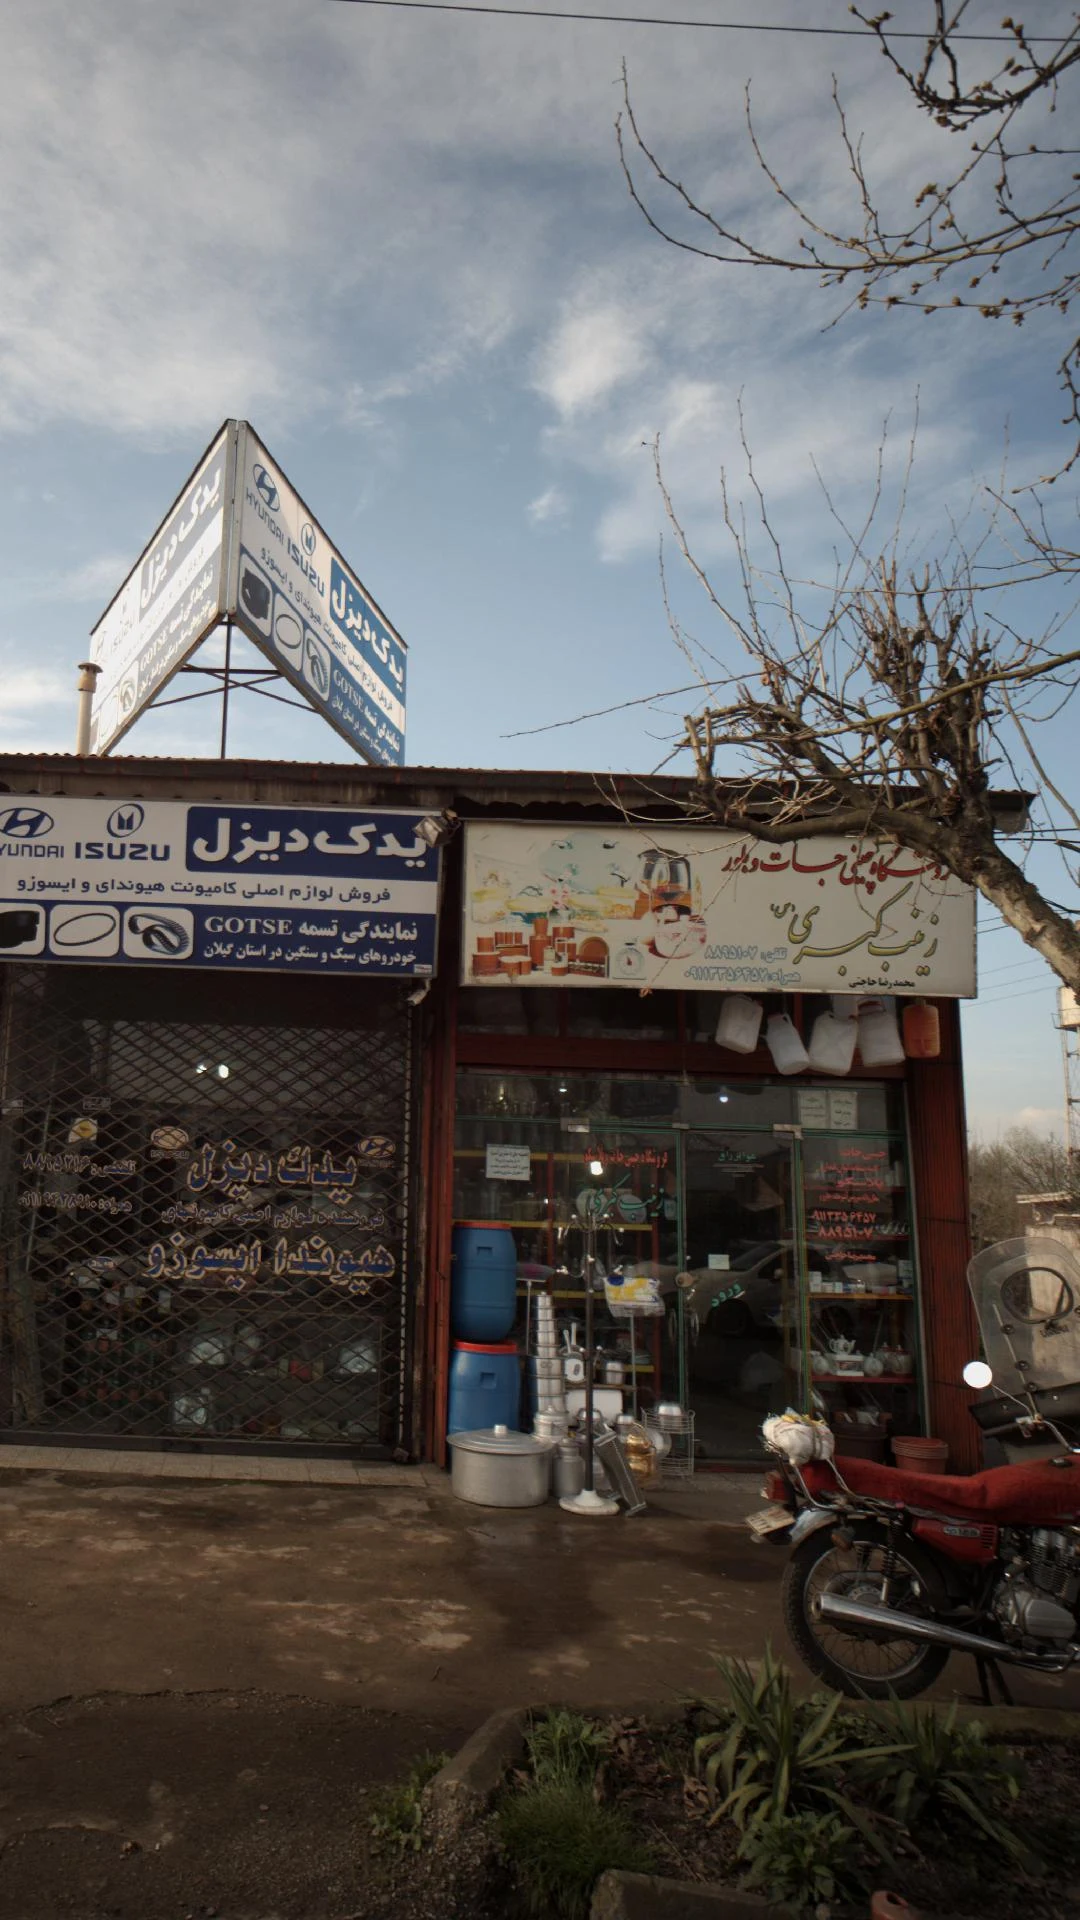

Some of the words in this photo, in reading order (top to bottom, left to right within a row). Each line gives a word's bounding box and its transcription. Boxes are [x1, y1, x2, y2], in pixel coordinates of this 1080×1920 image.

[245, 487, 285, 546] HYUNDAI
[287, 537, 325, 597] ISUZU
[331, 579, 371, 642] دیزل
[371, 631, 404, 692] یدک
[192, 817, 309, 863] دیزل
[313, 822, 427, 869] یدک
[0, 842, 65, 859] YUNDAI
[75, 841, 170, 861] ISUZU
[869, 846, 953, 883] روشگاه
[17, 876, 76, 892] ایسوزو
[81, 880, 90, 892] و
[96, 878, 165, 895] هیوندای
[170, 881, 237, 896] کامیونت
[242, 883, 284, 898] اصلی
[288, 885, 333, 901] لوازم
[339, 887, 391, 904] فروش
[204, 916, 293, 936] GOTSE
[298, 920, 339, 937] تسمه
[342, 920, 418, 944] نمایندگی
[788, 881, 915, 977] کبری
[868, 906, 941, 977] زینب
[235, 944, 267, 960] استان
[269, 947, 282, 961] در
[284, 945, 319, 961] سنگین
[320, 951, 328, 963] و
[330, 945, 357, 963] سبک
[711, 1283, 742, 1308] ورود
